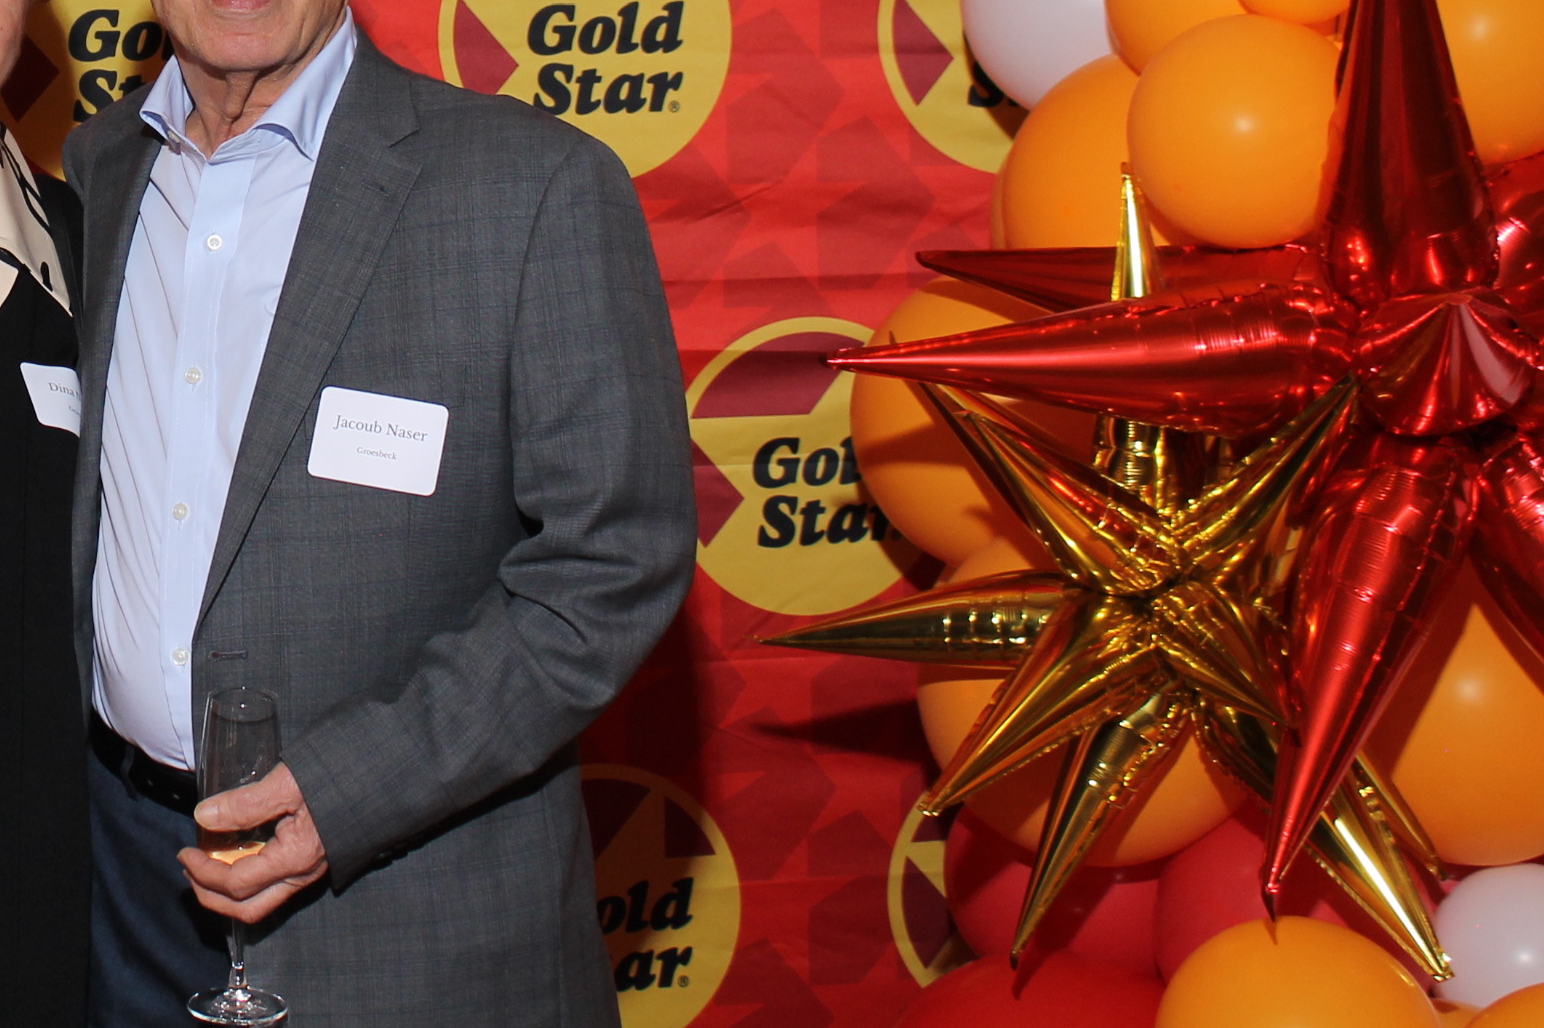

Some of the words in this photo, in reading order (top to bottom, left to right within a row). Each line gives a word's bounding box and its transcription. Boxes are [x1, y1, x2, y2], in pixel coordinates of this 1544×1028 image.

[68, 9, 175, 62] Go
[527, 0, 684, 56] Gold
[533, 63, 684, 115] Star
[48, 382, 75, 397] Dina
[333, 414, 382, 434] Jacoub
[386, 423, 428, 442] Naser
[753, 436, 861, 489] Gol
[597, 877, 694, 934] old
